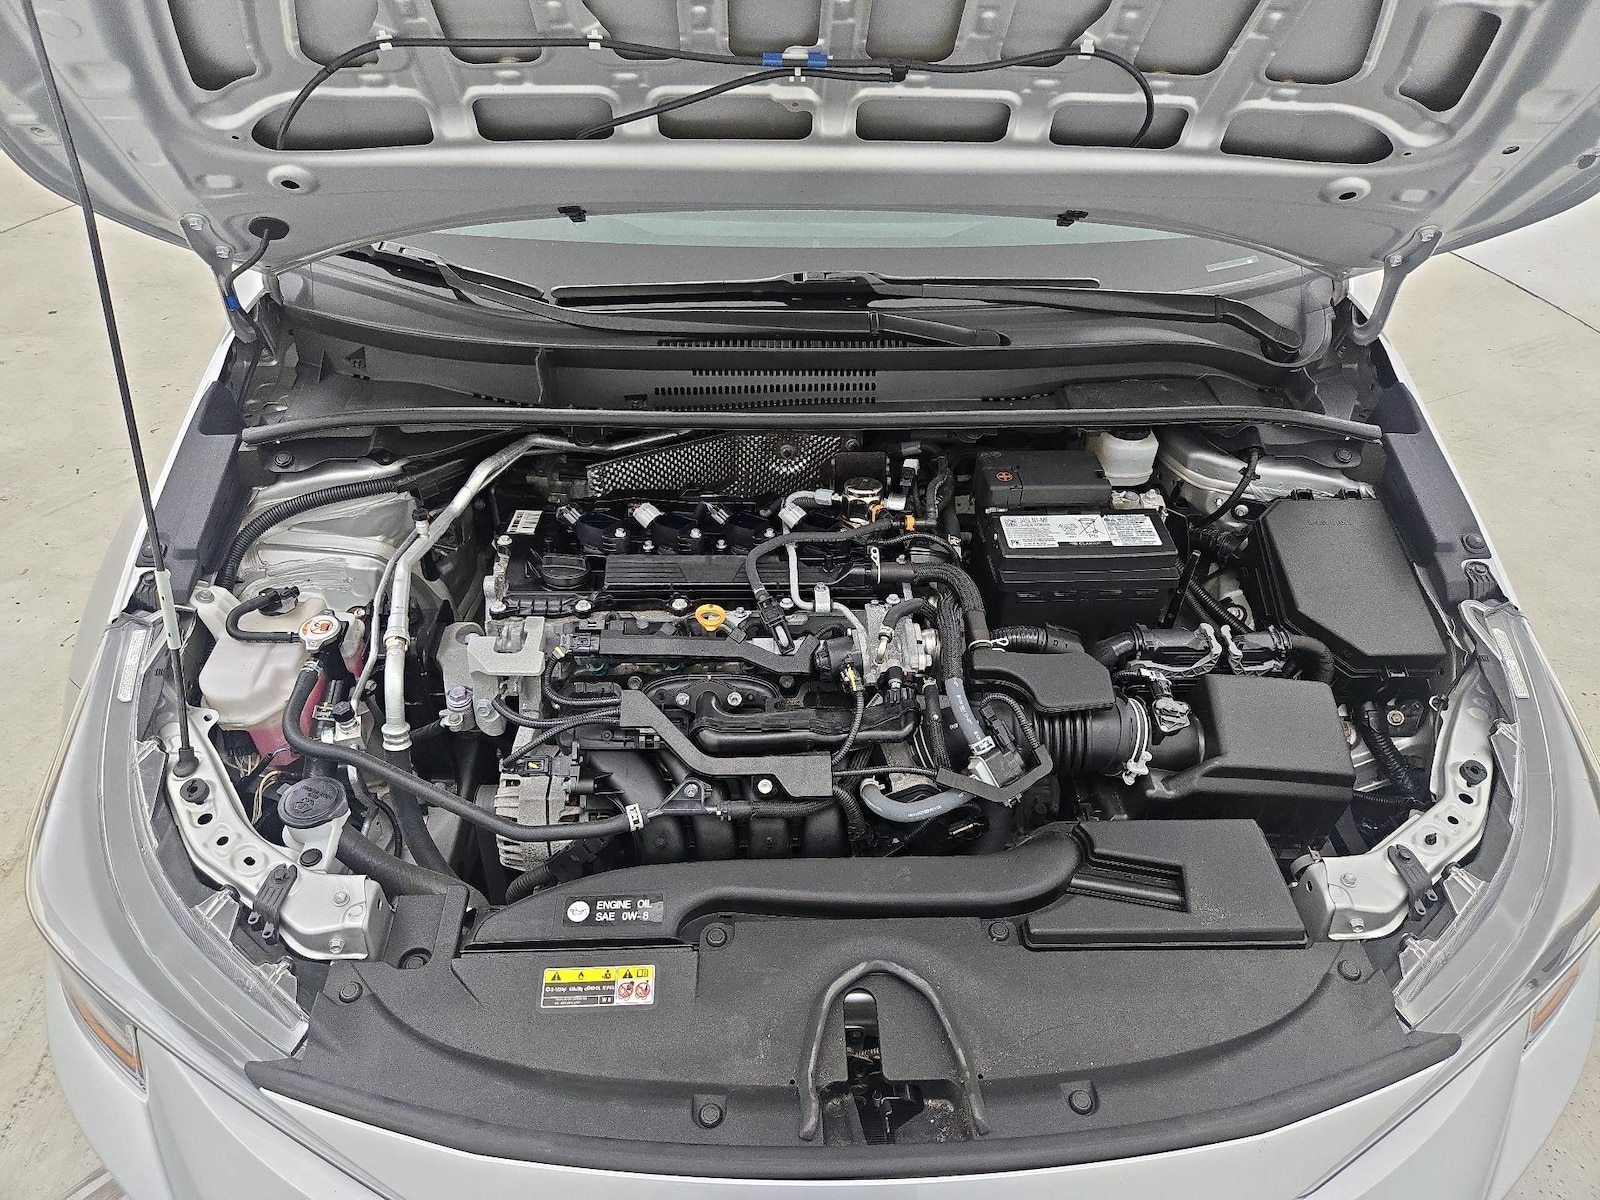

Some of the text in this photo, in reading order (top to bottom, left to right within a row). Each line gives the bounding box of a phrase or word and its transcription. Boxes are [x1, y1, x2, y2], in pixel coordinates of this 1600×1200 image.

[596, 899, 653, 910] ENGINE OIL
[595, 912, 649, 922] SAE 0W-8
